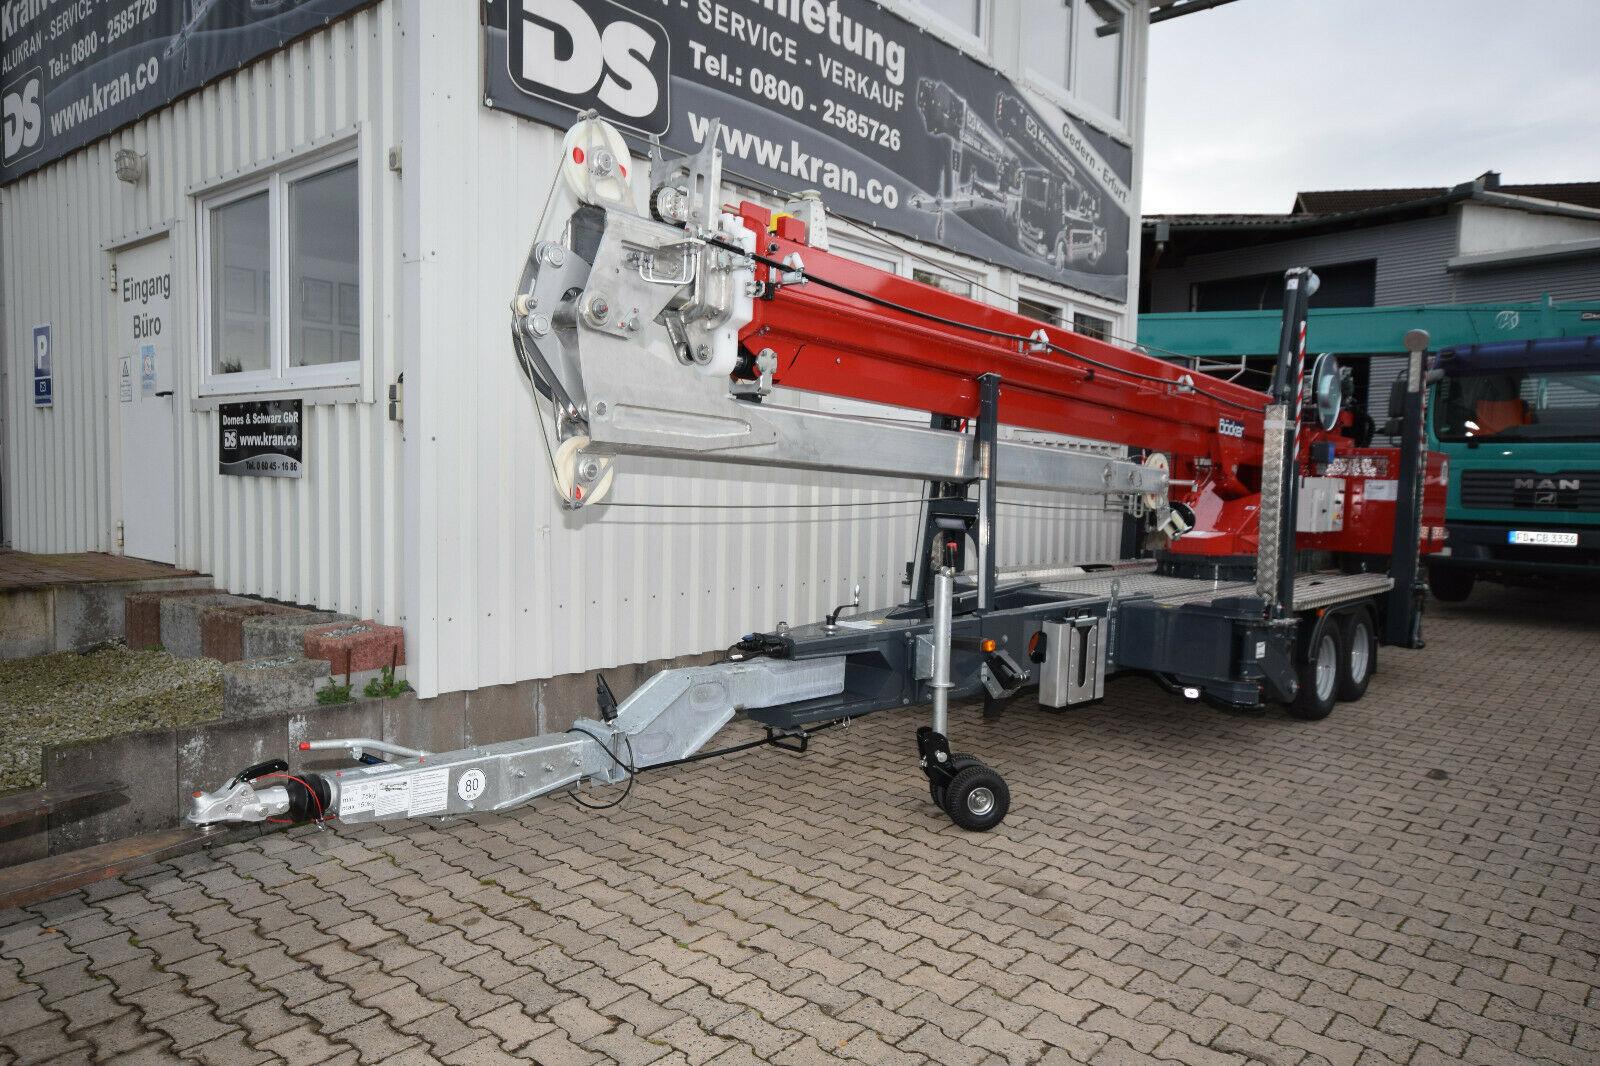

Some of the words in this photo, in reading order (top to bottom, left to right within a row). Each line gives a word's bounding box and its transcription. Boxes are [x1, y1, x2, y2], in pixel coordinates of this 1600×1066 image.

[1, 30, 42, 76] ALUKRAN
[50, 0, 93, 41] SERVICE
[49, 52, 70, 80] Tel.:
[71, 31, 98, 66] 0800
[522, 0, 659, 118] DS
[697, 0, 797, 64] SERVICE
[818, 53, 905, 112] VERKAUF
[51, 56, 159, 137] www.kran.co
[688, 39, 742, 87] Tel.:
[750, 67, 804, 111] 0800
[822, 99, 901, 151] 2585726
[687, 111, 899, 210] www.kran.co
[1062, 122, 1096, 169] Gedern
[1103, 168, 1128, 204] Erfurt
[123, 273, 171, 305] Eingang
[133, 312, 162, 339] Büro
[222, 414, 245, 426] Domes
[245, 413, 251, 425] &
[252, 412, 282, 425] Schwarz
[283, 411, 299, 423] GbR
[239, 431, 298, 447] www.kran.co
[282, 462, 289, 471] 16
[1514, 478, 1580, 490] MAN
[465, 778, 479, 793] 80
